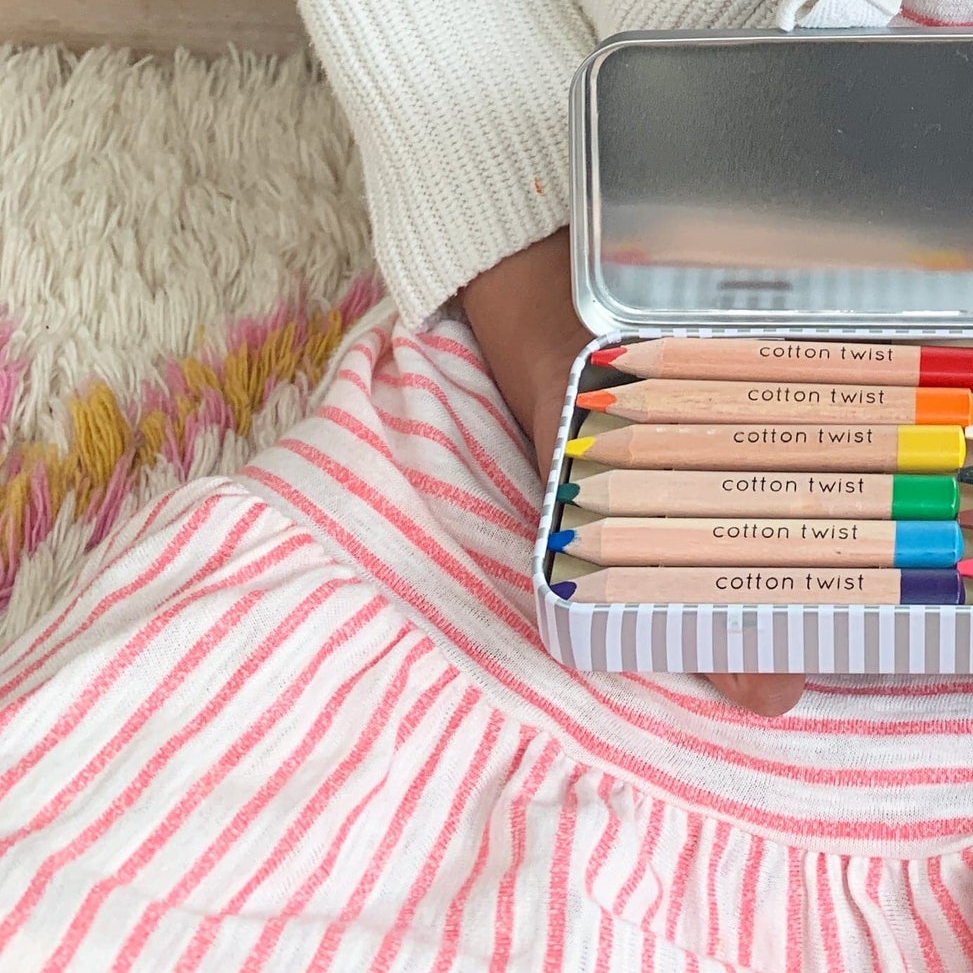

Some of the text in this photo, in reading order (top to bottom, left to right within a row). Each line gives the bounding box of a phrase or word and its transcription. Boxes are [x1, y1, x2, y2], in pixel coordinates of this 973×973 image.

[759, 344, 894, 362] cotton twist
[747, 386, 886, 405] cotton twist
[732, 428, 873, 444] cotton twist
[721, 475, 865, 494] cotton twist
[712, 523, 859, 541] cotton twist
[715, 572, 865, 592] cotton twist
